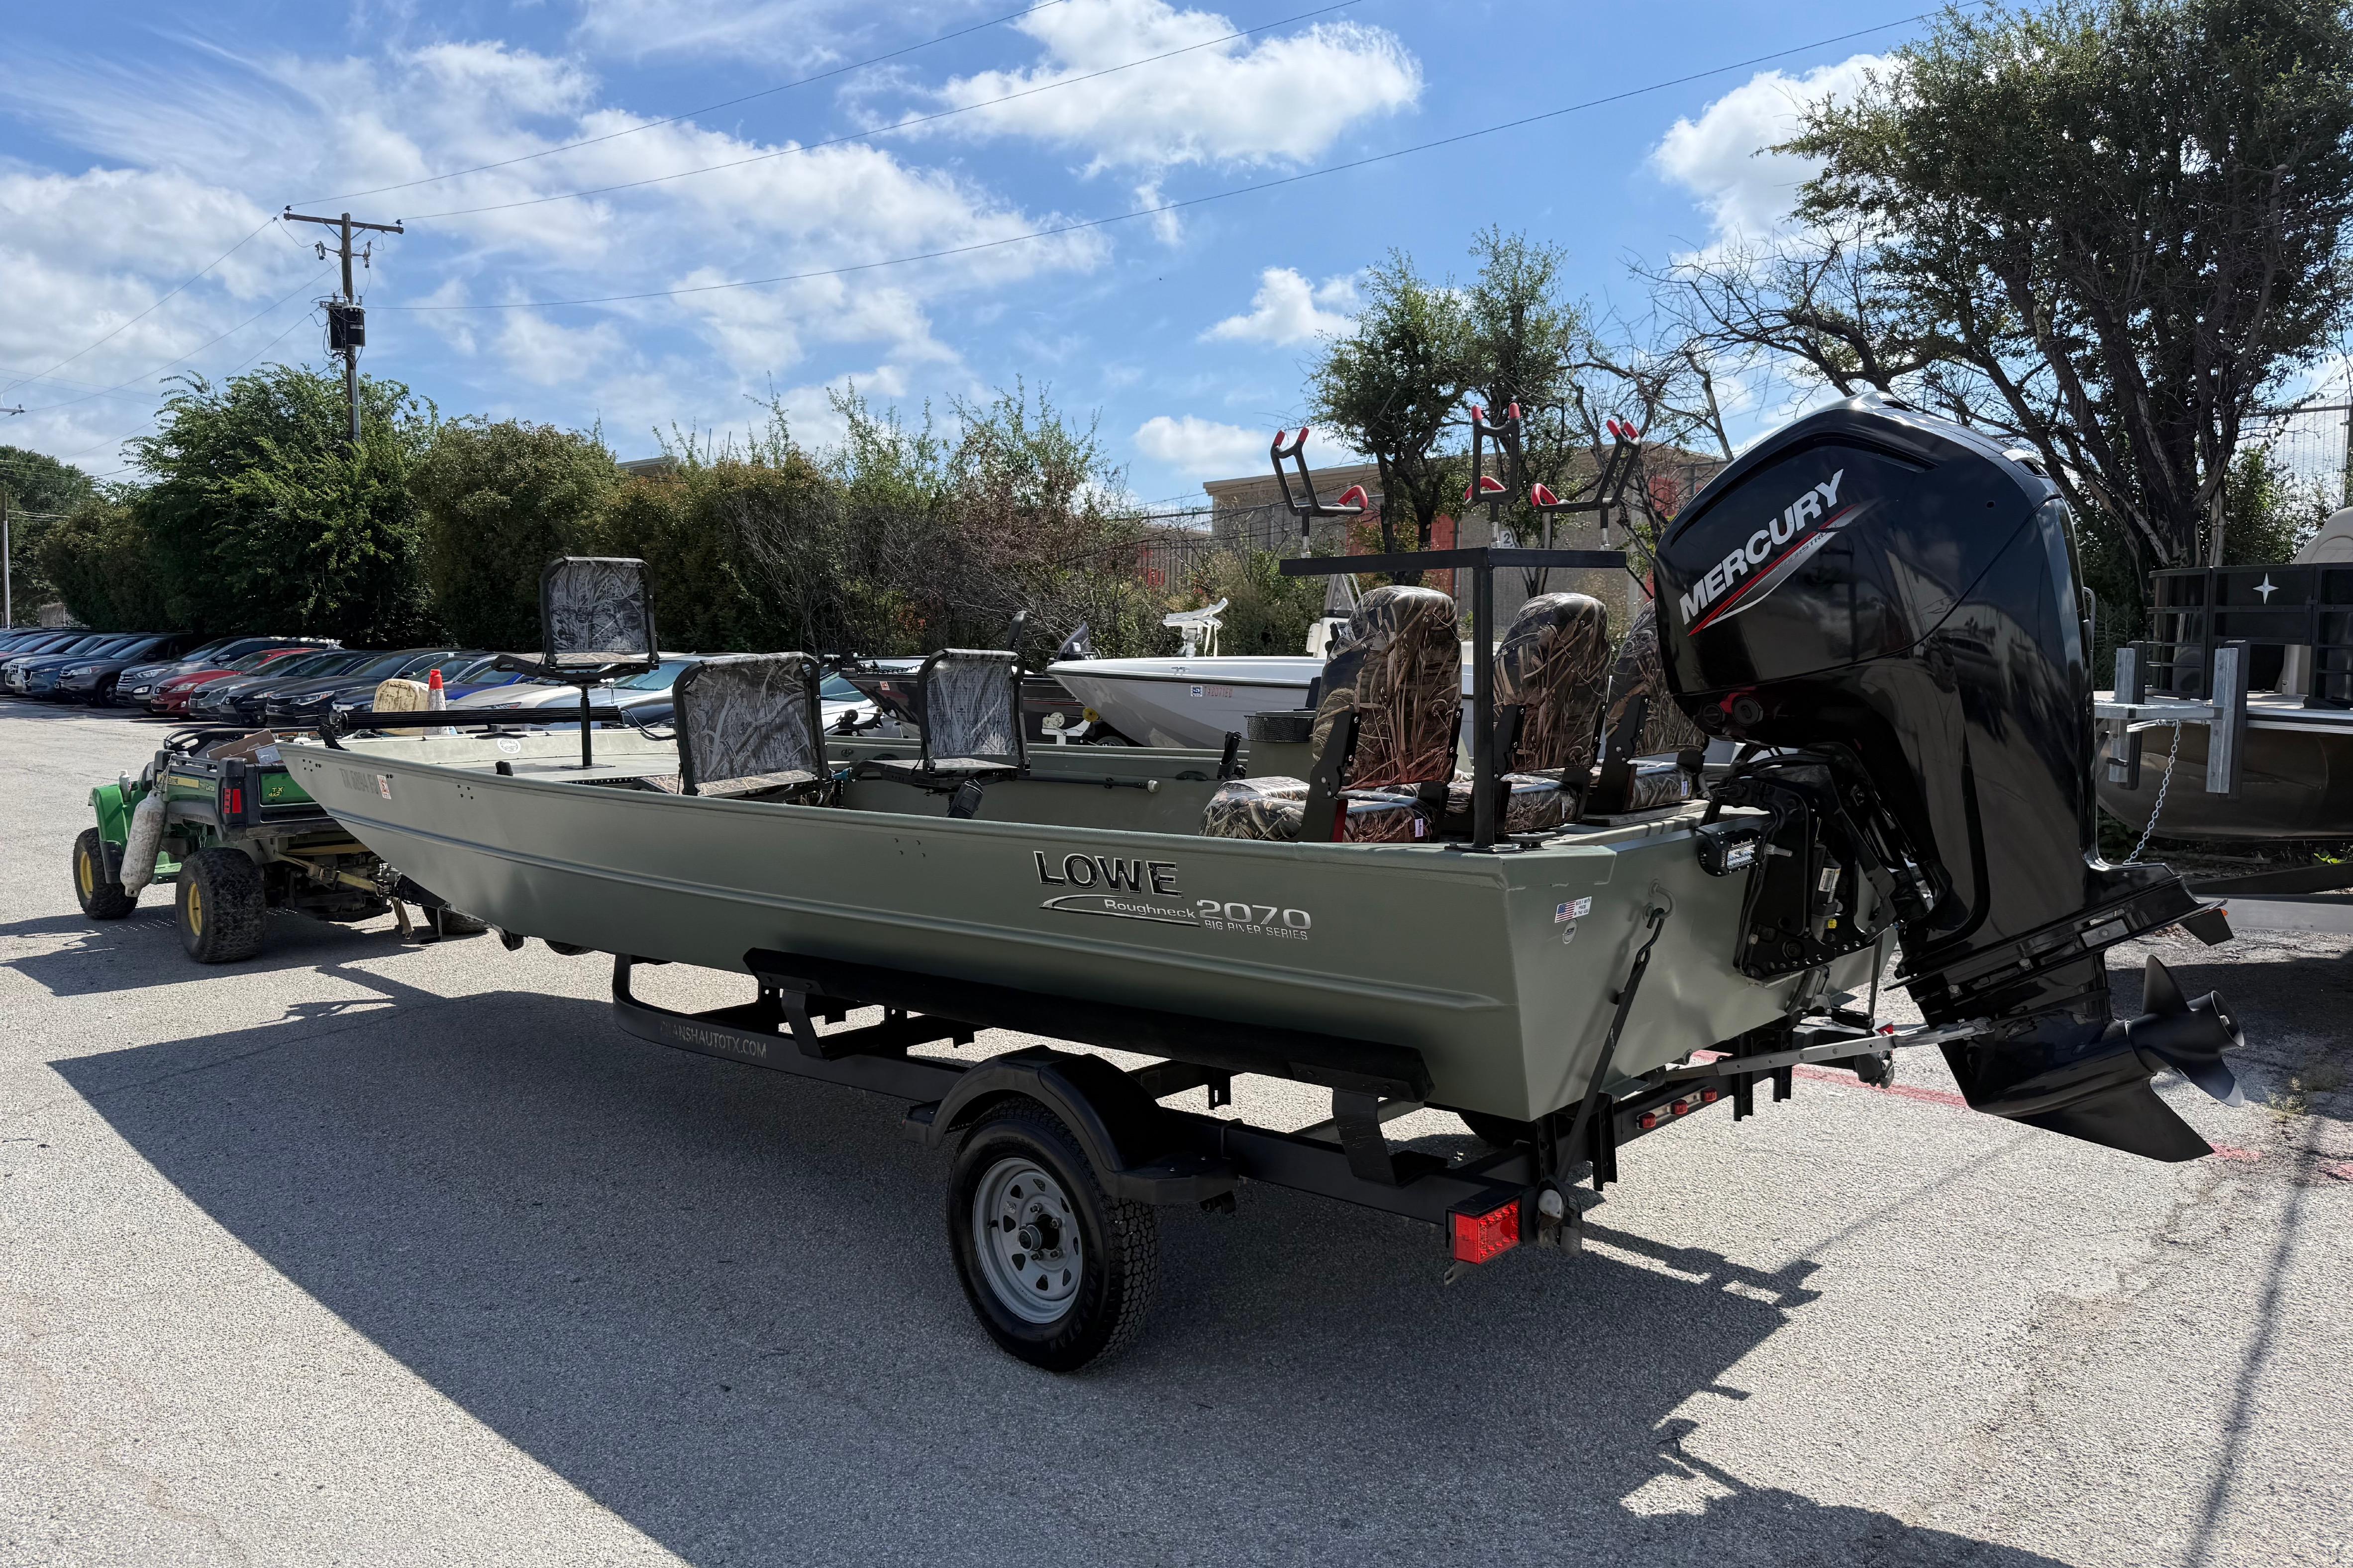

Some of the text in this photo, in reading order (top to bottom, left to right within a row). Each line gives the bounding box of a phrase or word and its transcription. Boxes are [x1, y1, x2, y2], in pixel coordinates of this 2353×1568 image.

[1679, 469, 1843, 625] MERCURY
[1033, 850, 1184, 898] LOWE
[1104, 899, 1312, 930] Roughneck 2070
[1205, 920, 1308, 940] BIG RIVER SERIES
